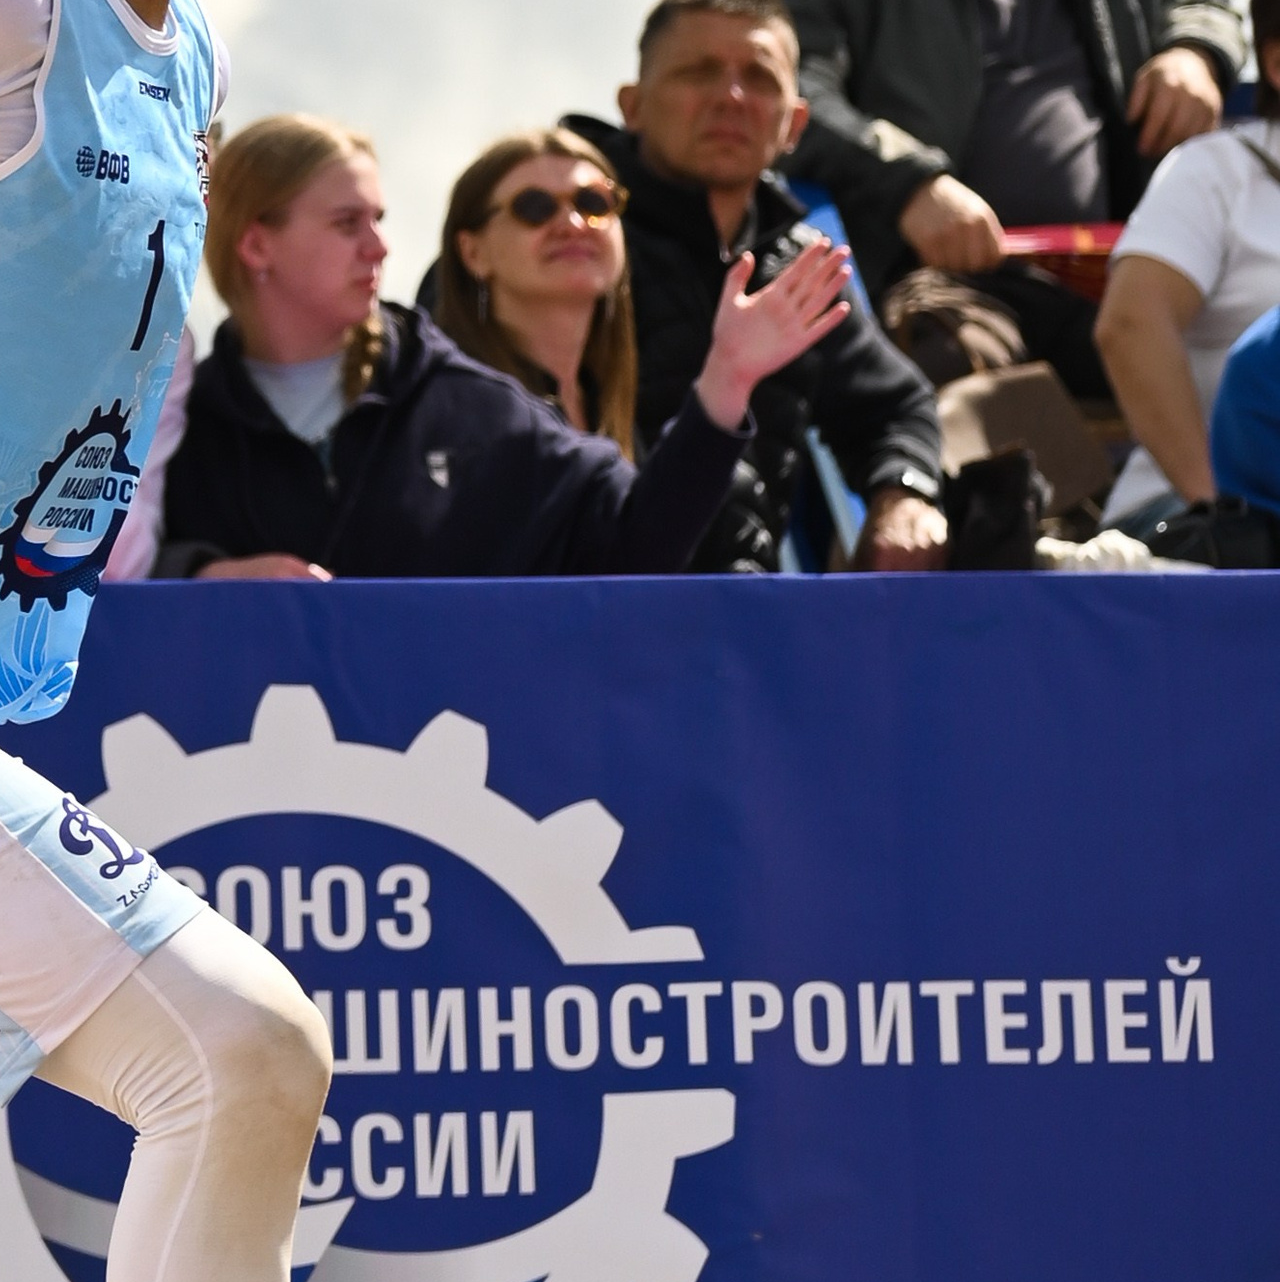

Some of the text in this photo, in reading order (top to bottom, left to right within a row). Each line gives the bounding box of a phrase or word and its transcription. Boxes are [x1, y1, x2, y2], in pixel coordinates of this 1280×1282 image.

[95, 149, 130, 184] ВФВ
[130, 219, 165, 351] 1
[75, 445, 113, 469] СОЮЗ
[57, 475, 138, 505] МАШИНОС
[38, 506, 96, 533] РОССИИ
[312, 955, 1215, 1075] ШИНОСТРОИТЕЛЕЙ
[305, 1110, 537, 1201] ССИИ
